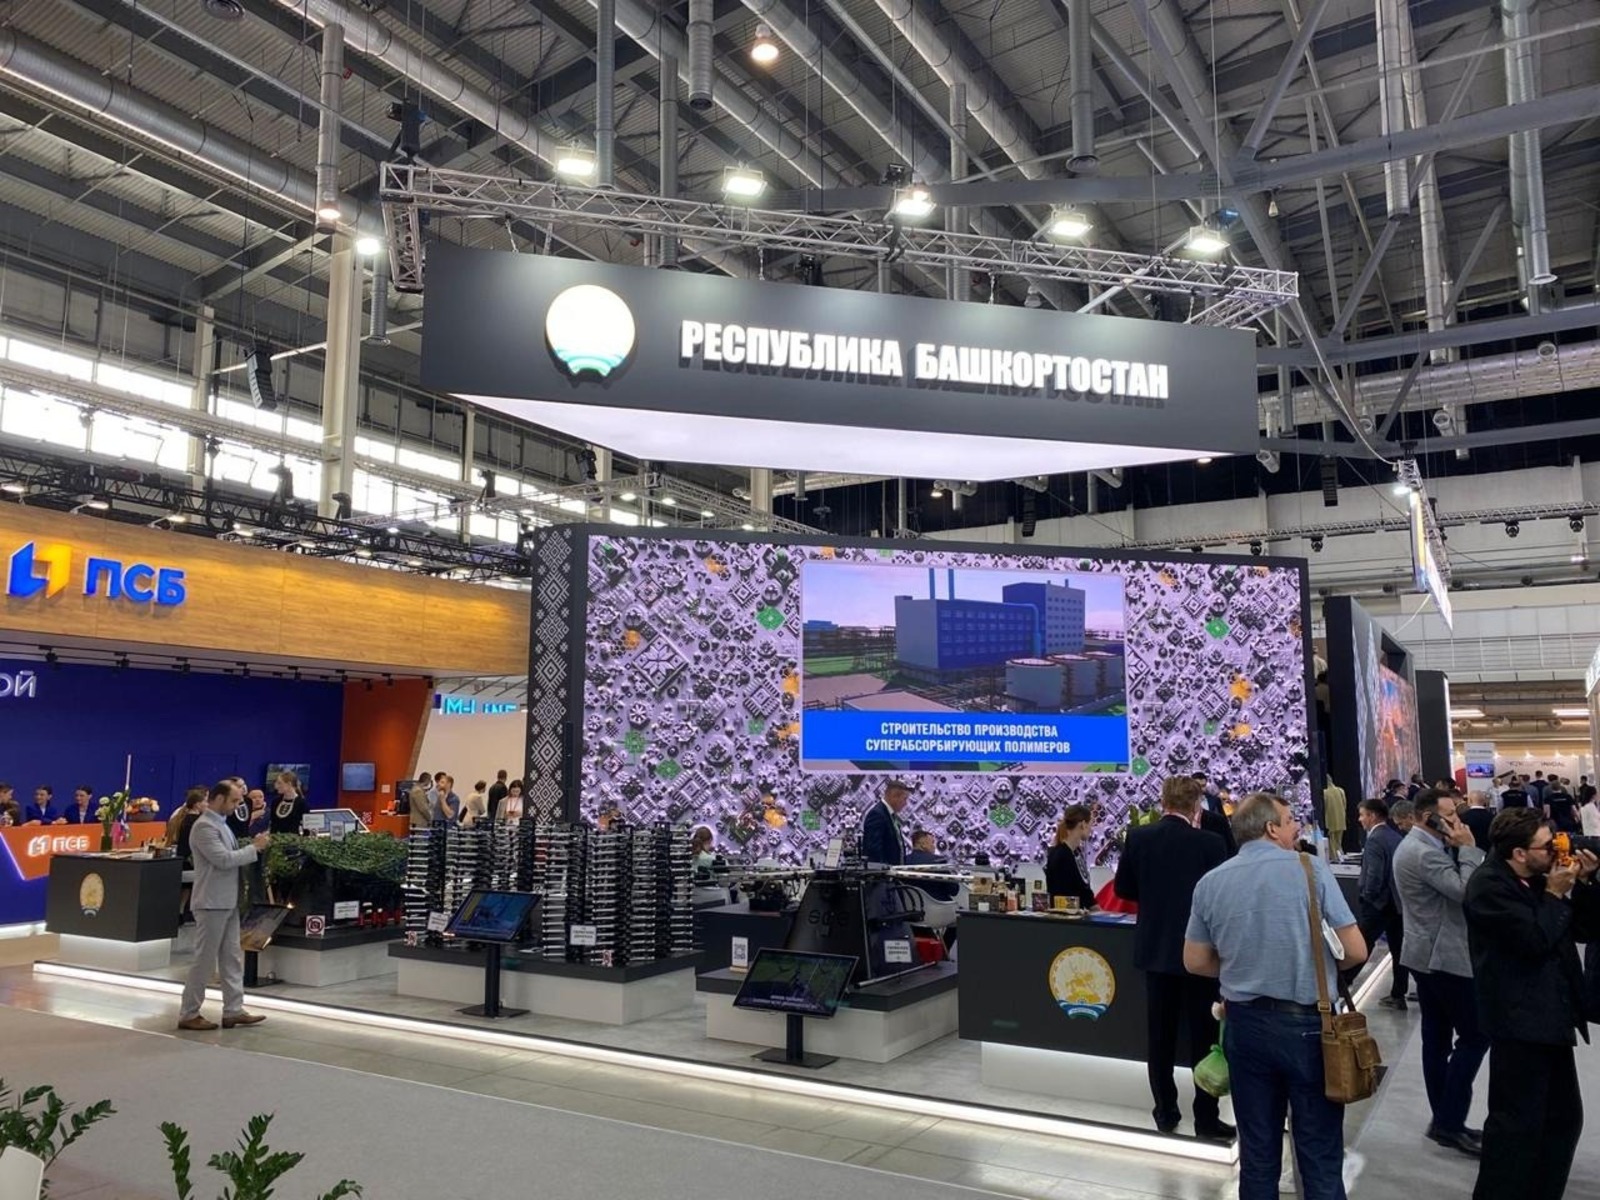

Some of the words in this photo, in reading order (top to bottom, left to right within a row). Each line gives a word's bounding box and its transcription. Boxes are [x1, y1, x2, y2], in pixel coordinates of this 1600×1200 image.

[680, 318, 904, 378] РЕСПУБЛИКА
[914, 341, 1170, 400] БАШКОРТОСТАН
[83, 556, 188, 606] ПСБ
[865, 739, 1002, 754] СУПЕРАБСОРБИРУЮЩИХ
[1003, 741, 1071, 754] ПОЛИМЕРОВ
[880, 722, 971, 736] СТРОИТЕЛЬСТВО
[974, 723, 1059, 738] ПРОИЗВОДСТВА
